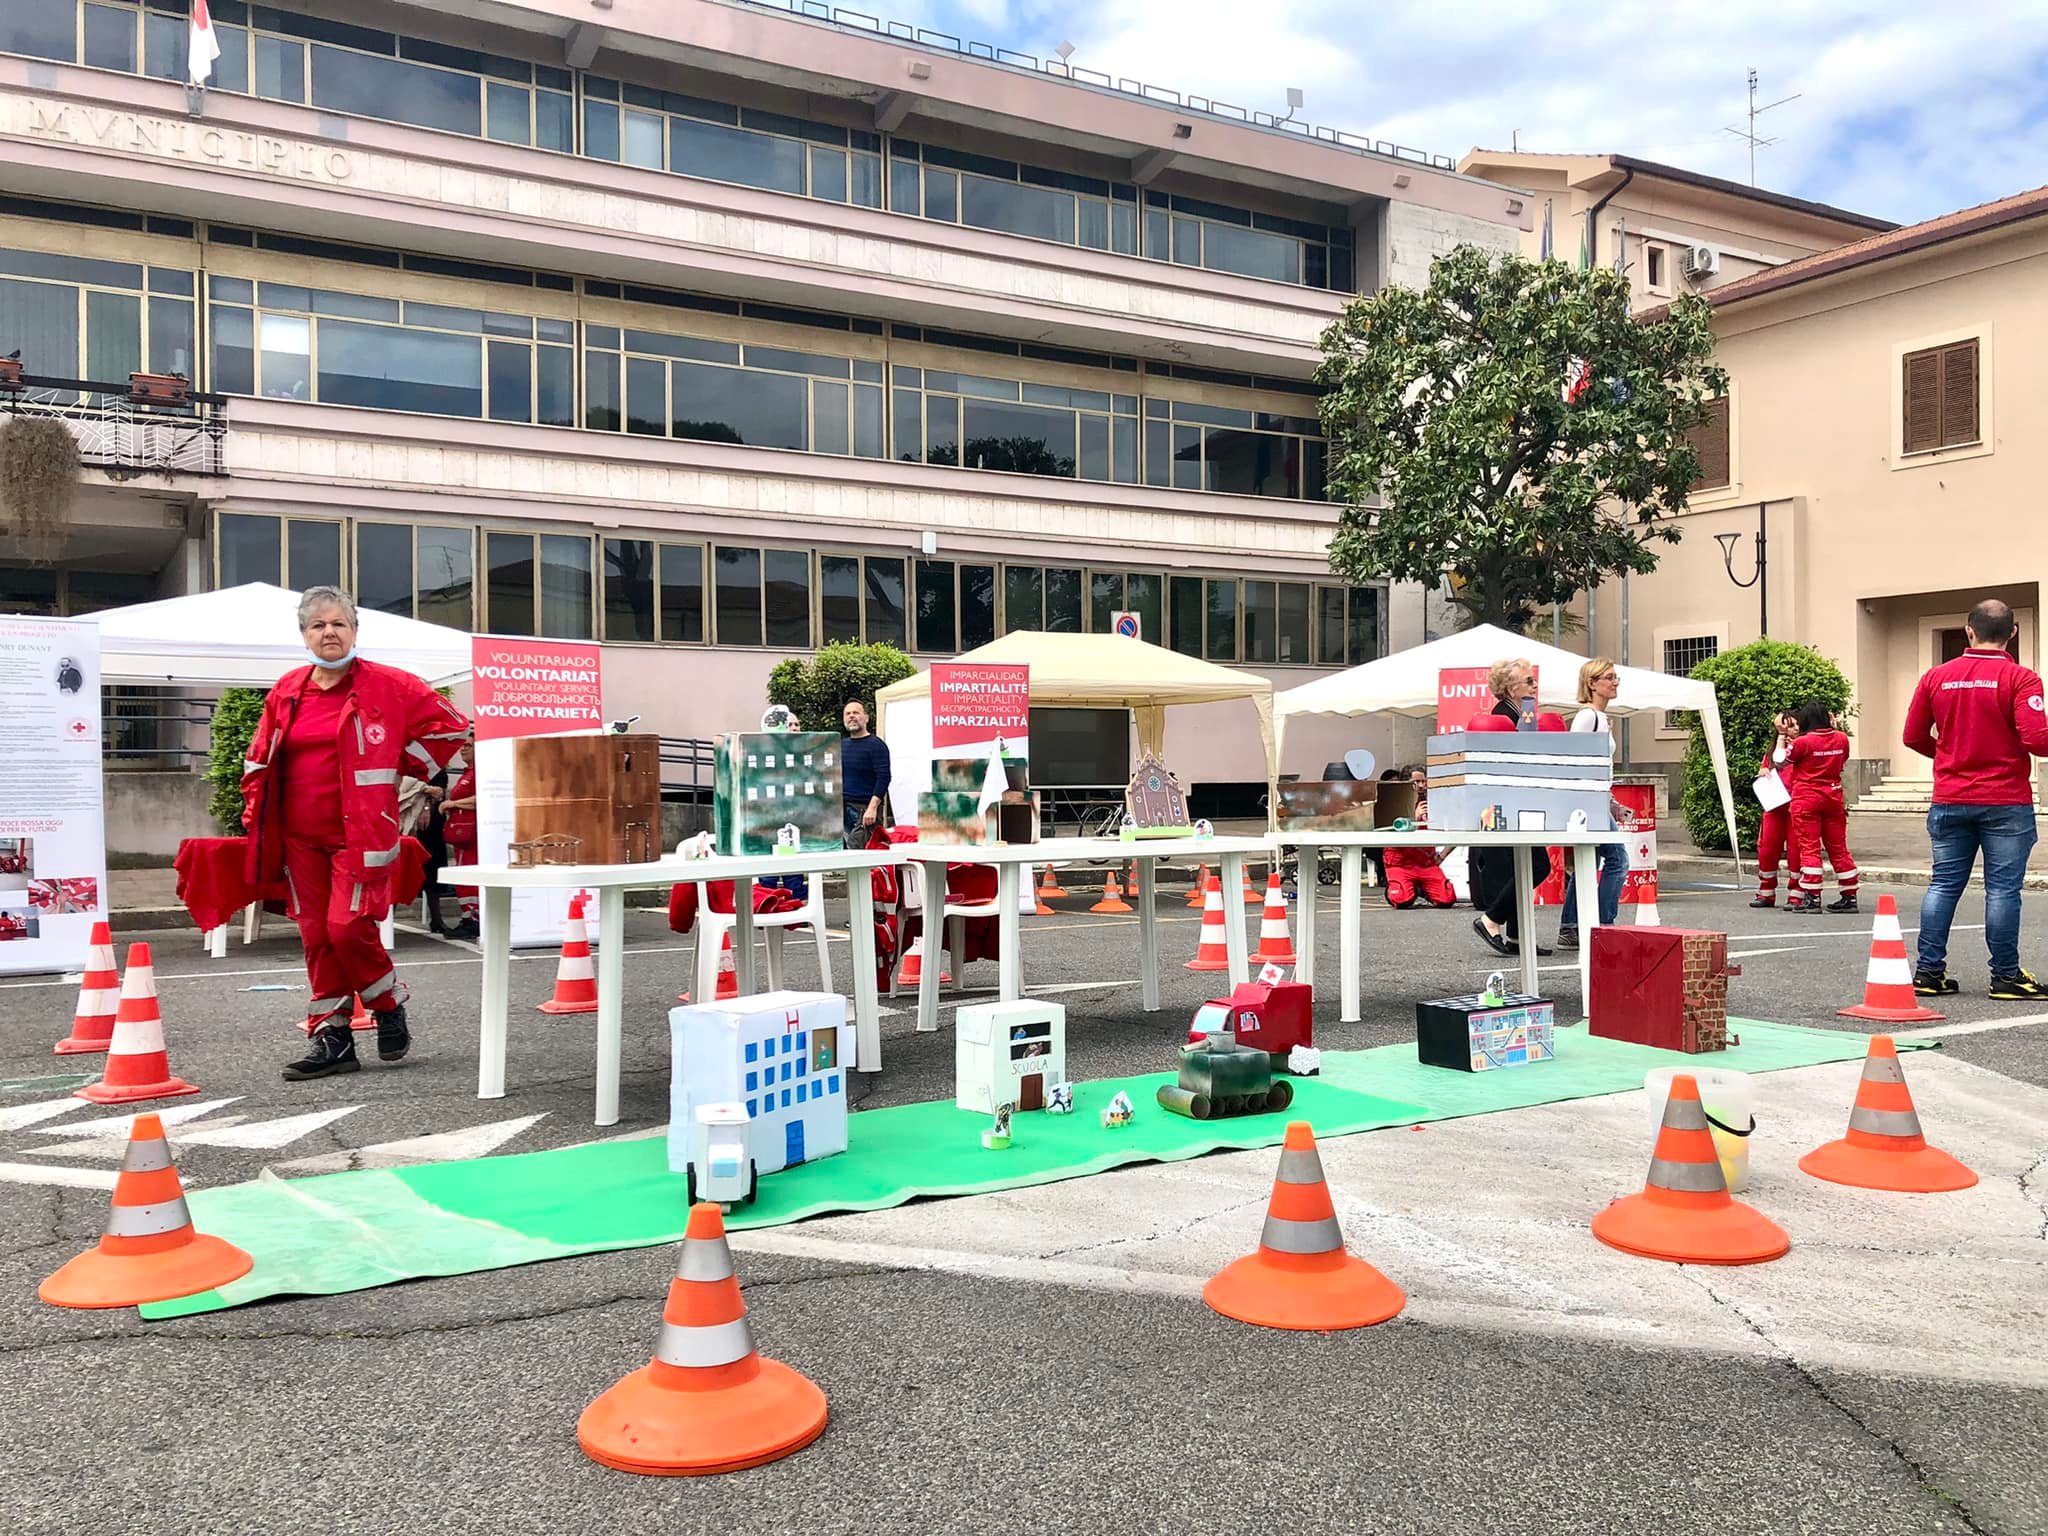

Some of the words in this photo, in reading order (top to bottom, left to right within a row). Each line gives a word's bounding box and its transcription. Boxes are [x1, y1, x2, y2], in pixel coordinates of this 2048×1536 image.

[28, 100, 352, 180] MVNICIPIO
[490, 652, 596, 668] VOLUNTARIADO
[475, 666, 599, 683] VOLONTARIAT
[950, 671, 1025, 681] IMPARCIALIDAD
[494, 681, 557, 693] VOLUNTARY
[559, 684, 599, 695] SERVICE
[940, 681, 1028, 694] IMPARTIALITÉ
[1442, 684, 1495, 698] UNIT
[492, 691, 601, 706] ДОБРОВОЛЬНОСТЬ
[953, 693, 1024, 705] IMPARTIALITY
[475, 705, 601, 720] VOLONTARIETÀ
[940, 704, 1021, 713] БЕСПРИСТРАСТНОСТЬ
[934, 714, 1029, 727] IMPARZIALITÀ
[785, 1009, 800, 1034] H
[1011, 1058, 1049, 1076] SCUOLA
